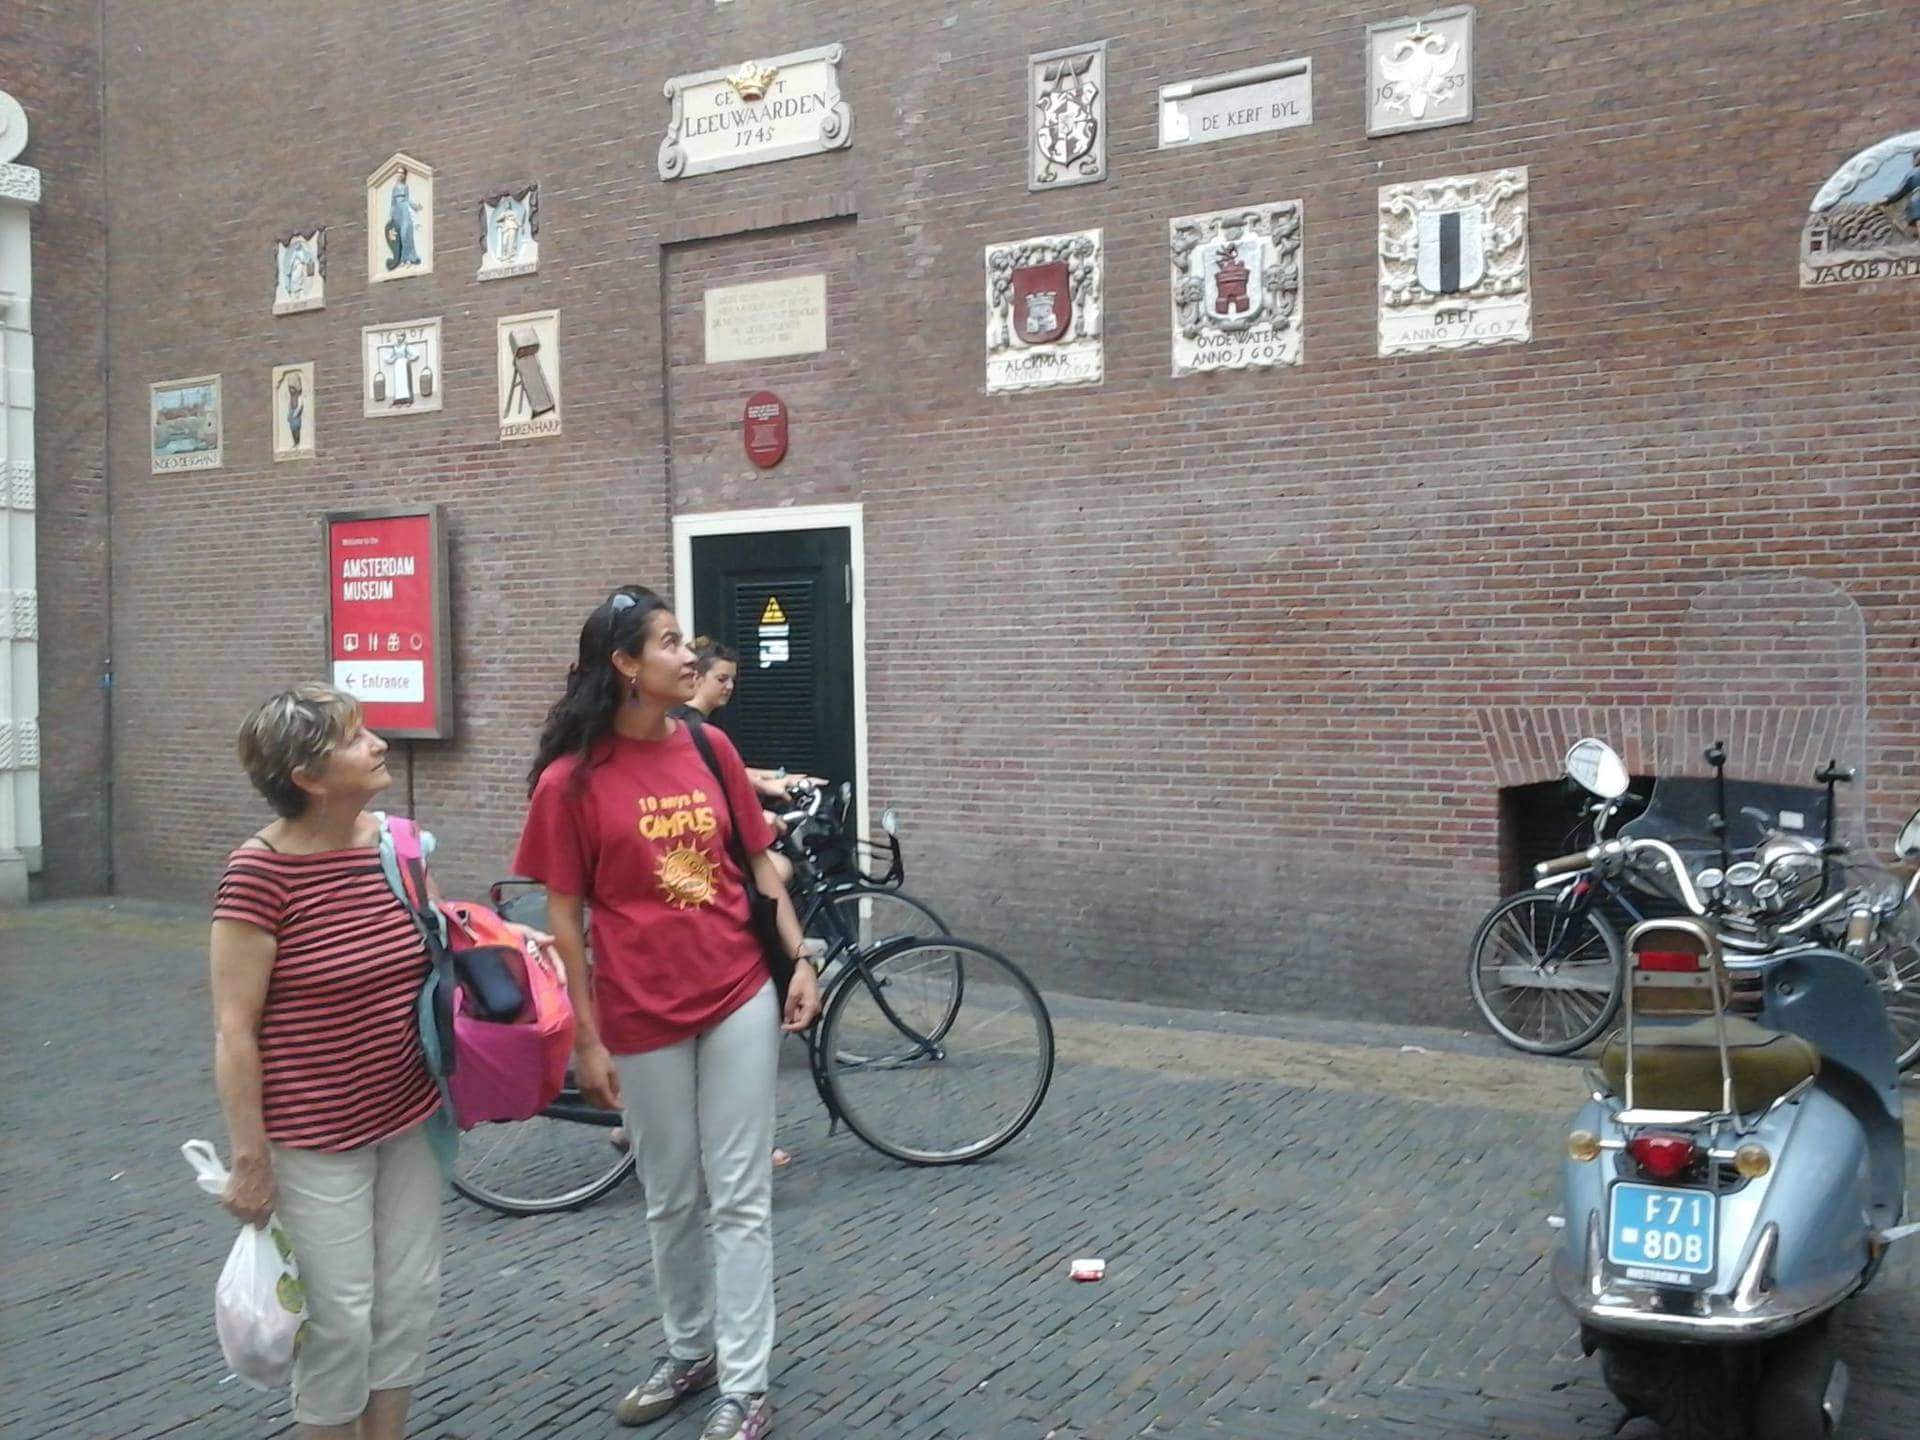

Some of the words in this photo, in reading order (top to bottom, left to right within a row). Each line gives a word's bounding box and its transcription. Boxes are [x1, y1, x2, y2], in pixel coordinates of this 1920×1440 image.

[685, 92, 826, 138] LEEUWAARDEN
[1202, 117, 1219, 132] DE
[1228, 107, 1263, 127] KERF
[1271, 101, 1300, 119] BYL
[735, 126, 774, 147] 1745
[1811, 264, 1880, 285] JACOB
[1401, 328, 1448, 342] ANNO
[1192, 350, 1232, 367] ANNO
[343, 556, 415, 579] AMSTERDAM
[343, 580, 393, 601] MUSEUM
[362, 673, 410, 689] Entrance
[638, 796, 657, 813] 10
[639, 807, 716, 840] CAMPUS
[1645, 1194, 1702, 1228] F71
[1643, 1229, 1702, 1263] 8DB
